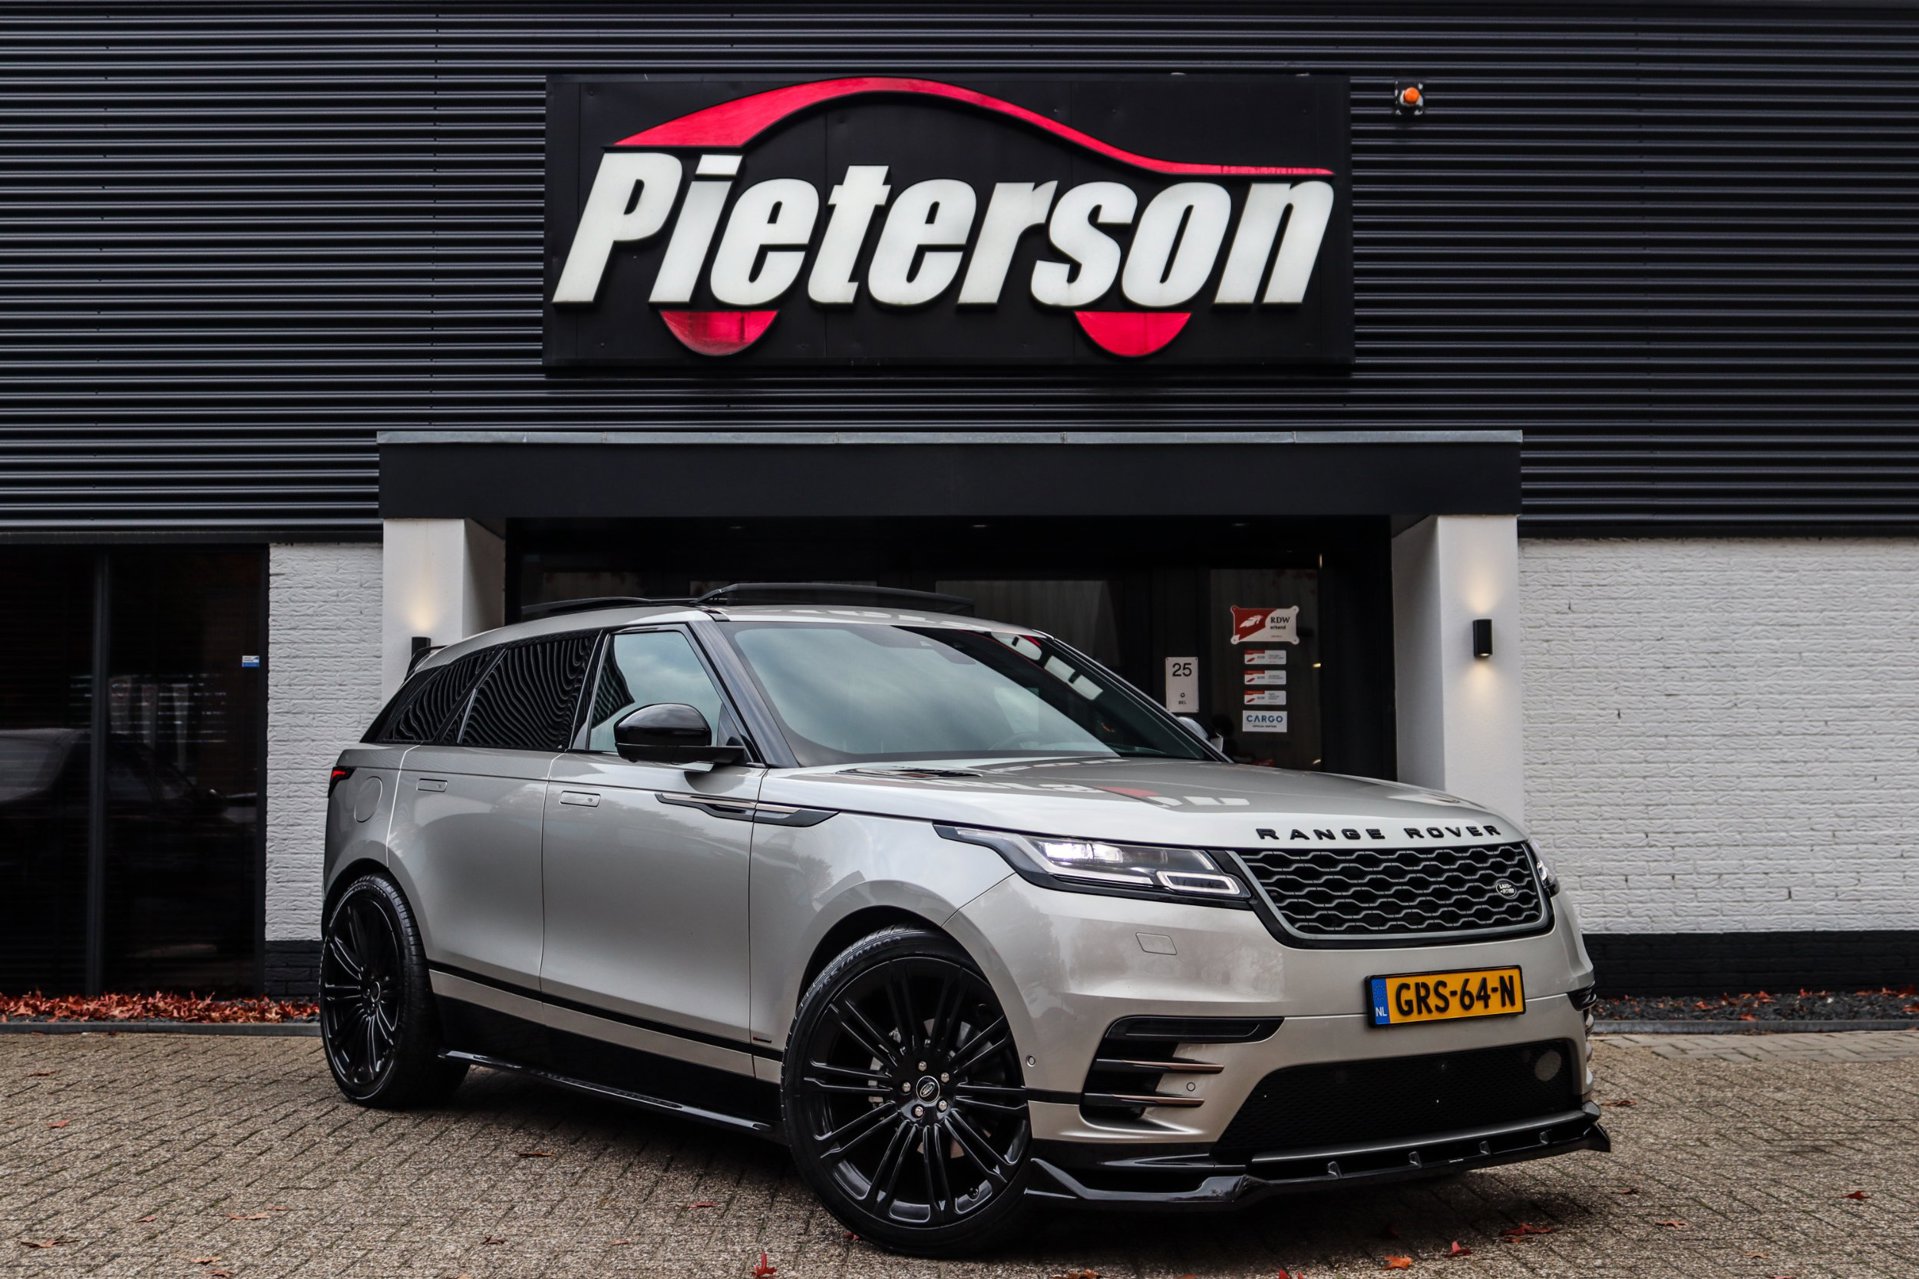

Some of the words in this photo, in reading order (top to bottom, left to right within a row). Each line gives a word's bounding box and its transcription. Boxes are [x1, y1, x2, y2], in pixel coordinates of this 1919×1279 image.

[551, 152, 1335, 307] Pieterson
[1270, 616, 1291, 624] RDW
[1172, 662, 1192, 677] 25
[1246, 715, 1283, 723] CARGO
[1255, 828, 1386, 840] RANGE
[1403, 825, 1501, 839] ROVER
[1395, 975, 1516, 1017] GRS-64-N
[1375, 1007, 1388, 1017] NL
